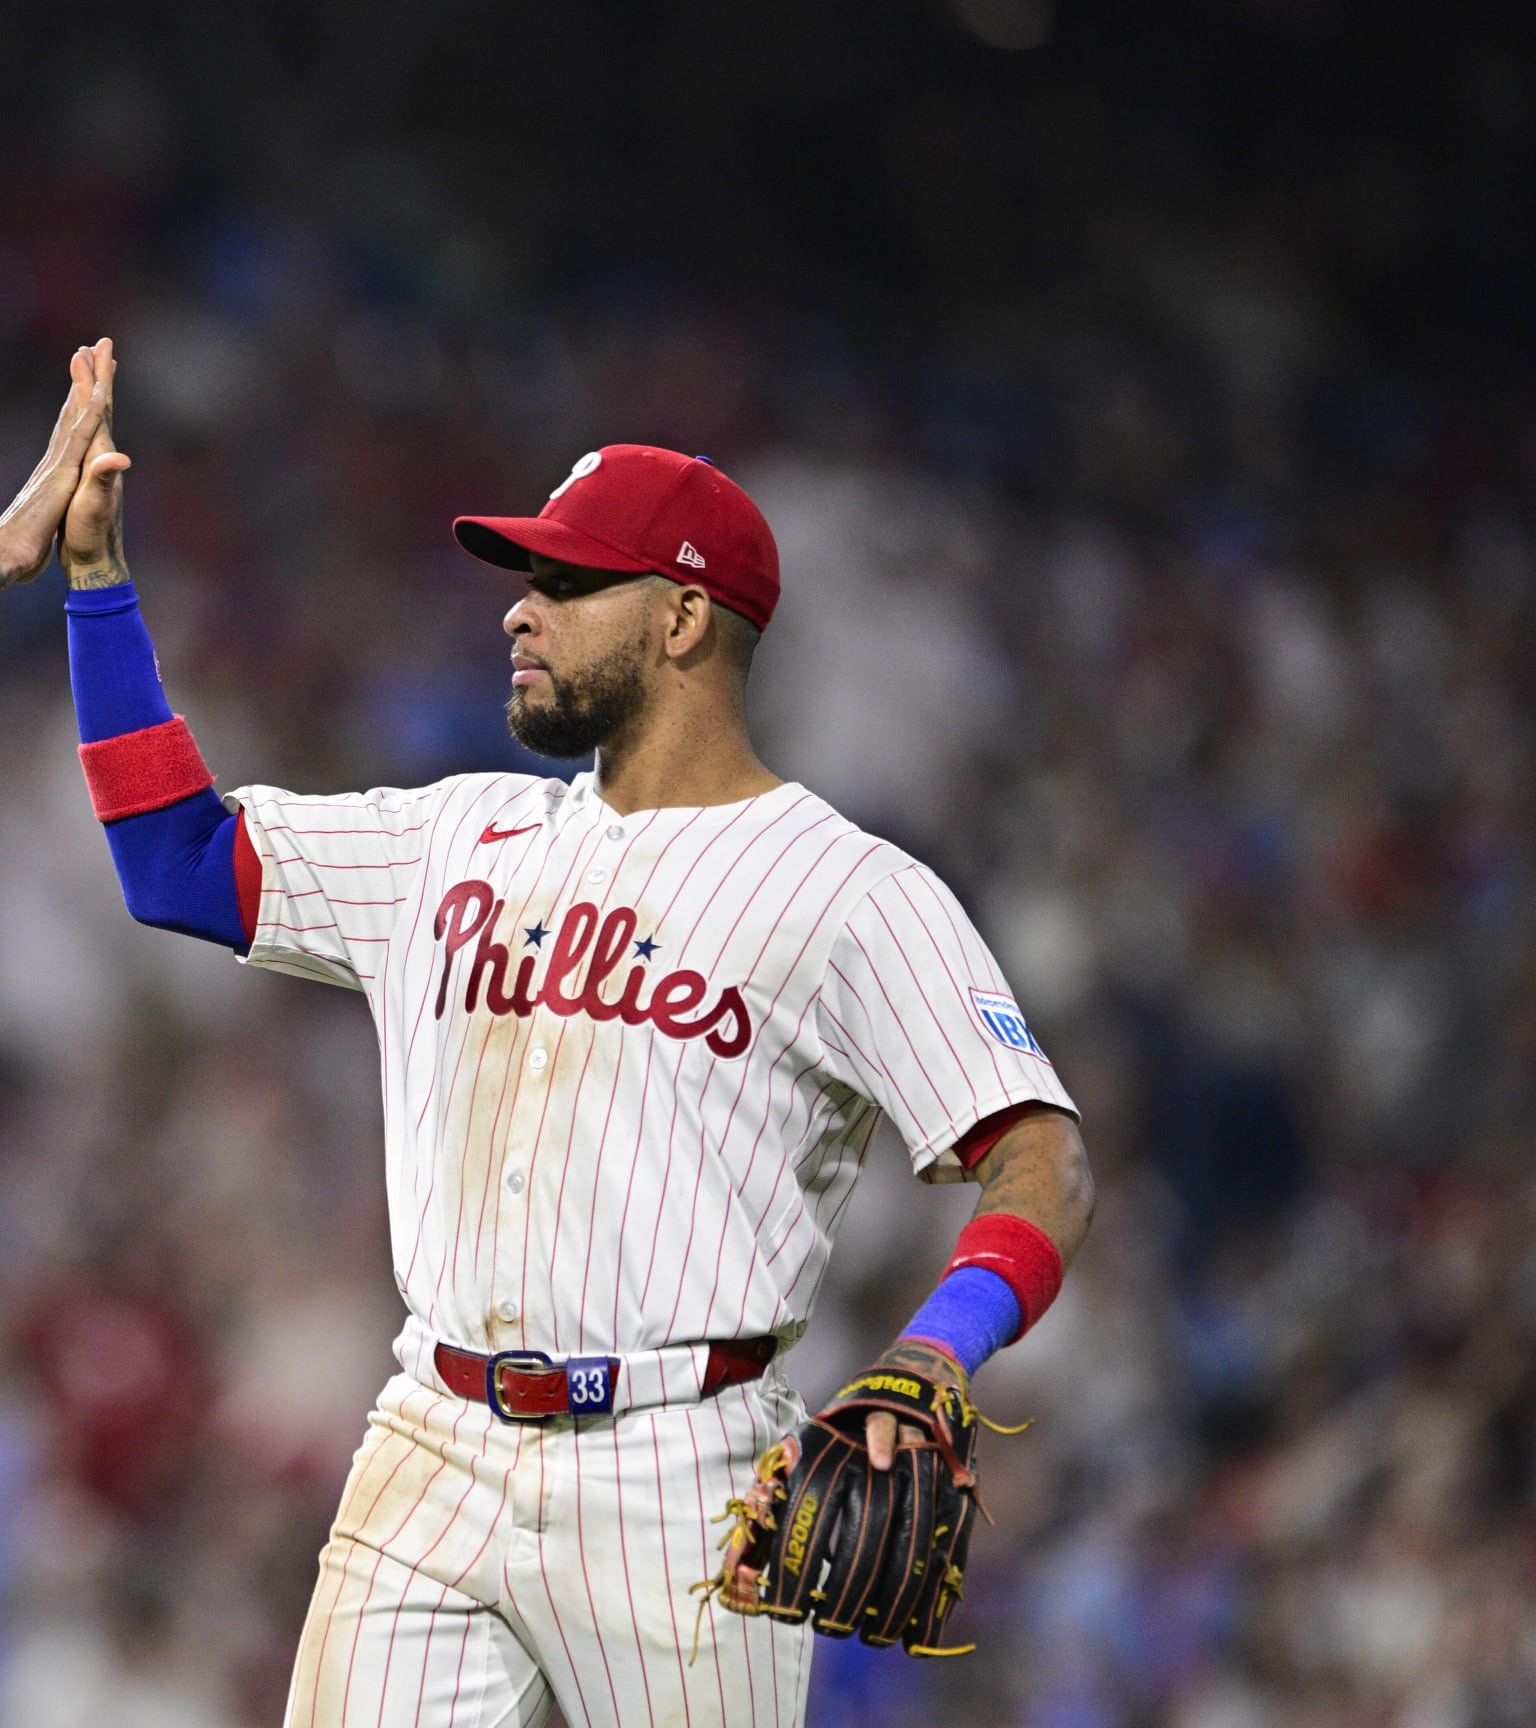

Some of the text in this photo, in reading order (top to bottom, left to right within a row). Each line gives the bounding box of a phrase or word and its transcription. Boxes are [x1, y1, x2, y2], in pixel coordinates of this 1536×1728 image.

[434, 880, 752, 1059] Phillies
[571, 1370, 606, 1404] 33
[785, 1494, 819, 1576] A2000
